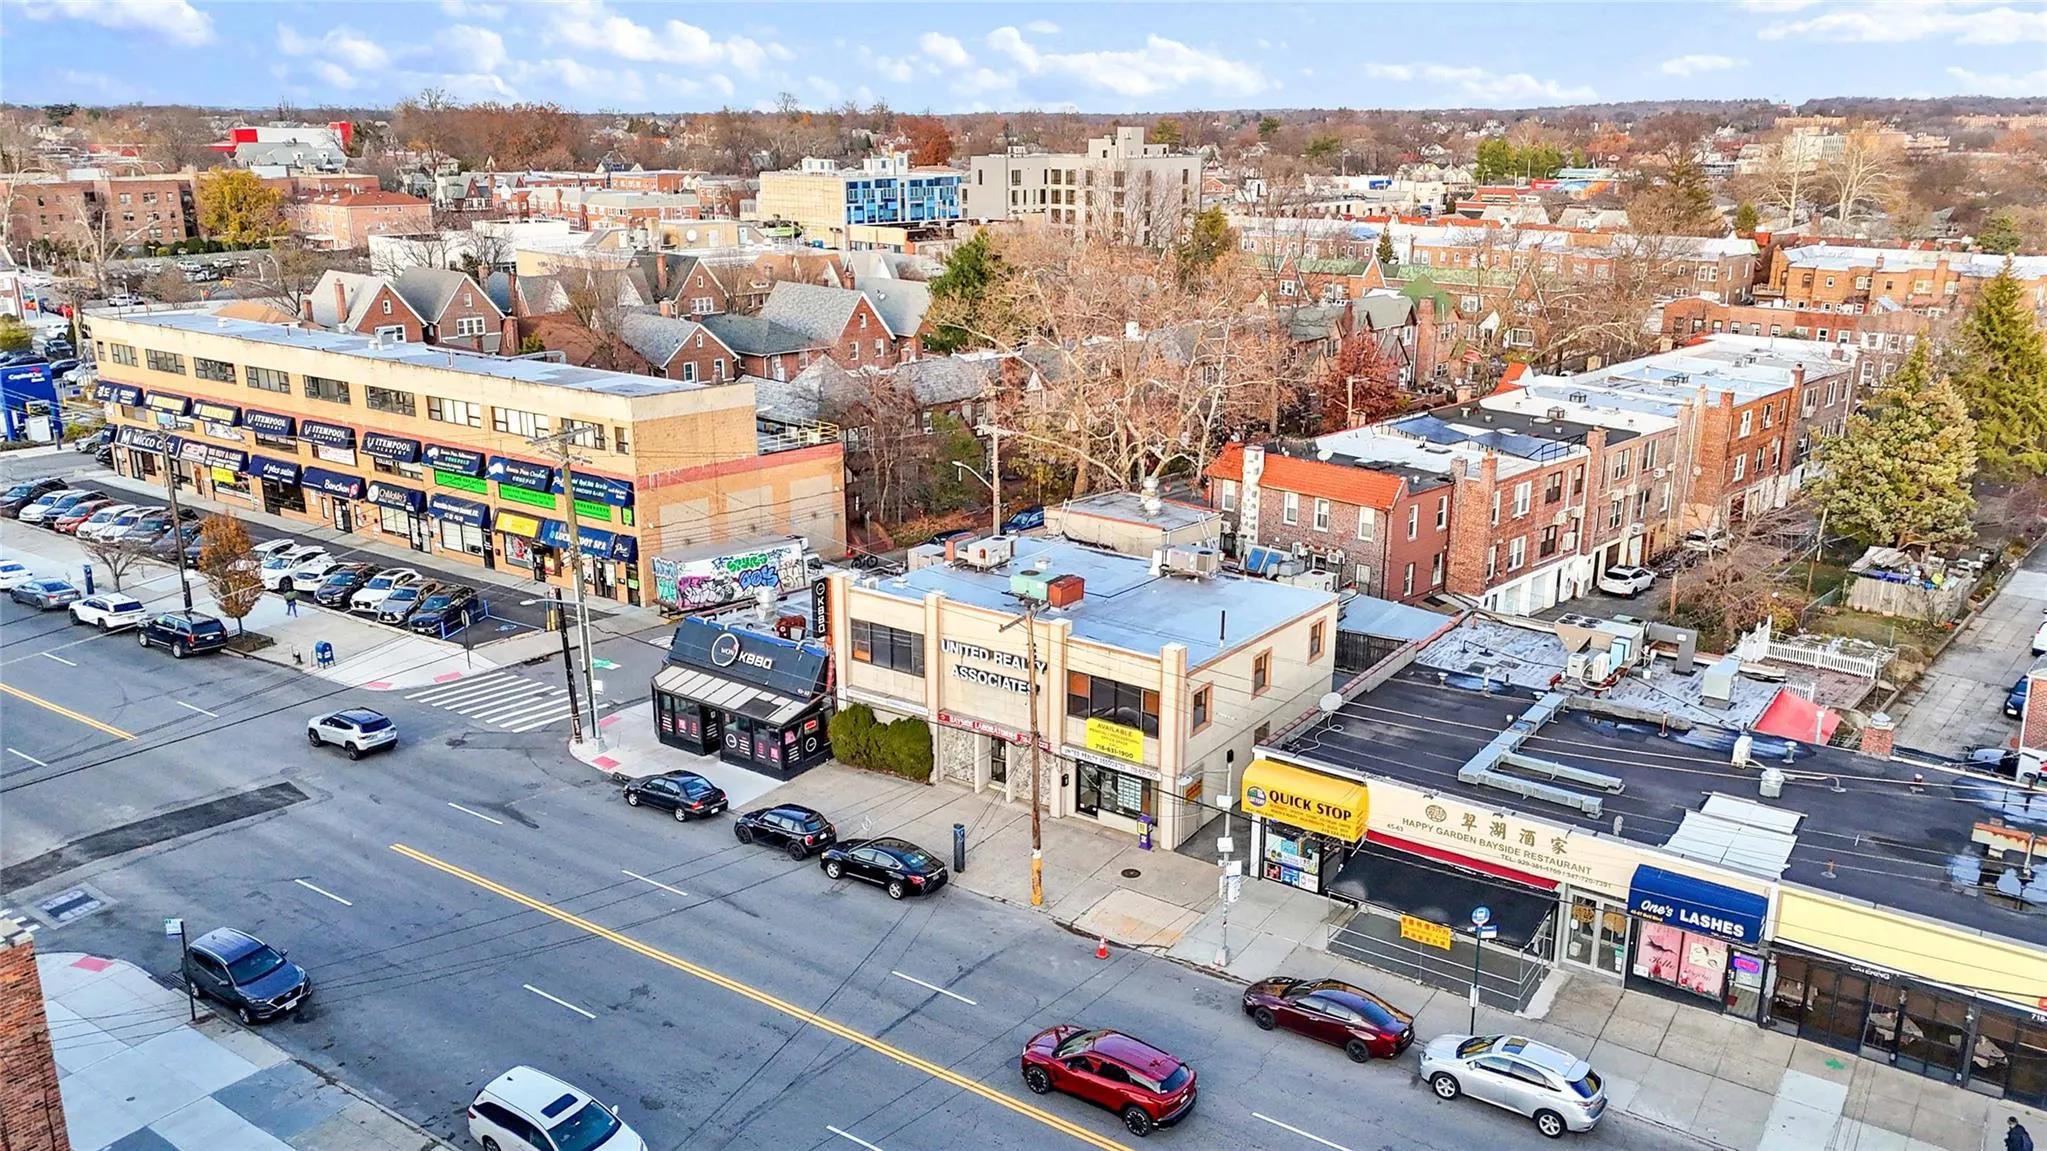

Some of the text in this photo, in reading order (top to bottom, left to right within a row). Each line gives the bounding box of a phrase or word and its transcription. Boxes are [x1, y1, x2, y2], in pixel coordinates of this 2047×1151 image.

[737, 650, 773, 670] KBBQ
[942, 639, 1047, 677] UNITED REALY
[1097, 723, 1133, 738] AVAILABLE
[1269, 790, 1352, 821] QUICK STOP
[1402, 817, 1592, 876] HAPPY GARDEN BAYSIDE RESTAURANT
[1461, 812, 1568, 855] 翠湖酒家
[1640, 900, 1674, 917] One's
[1680, 909, 1744, 938] LASHES
